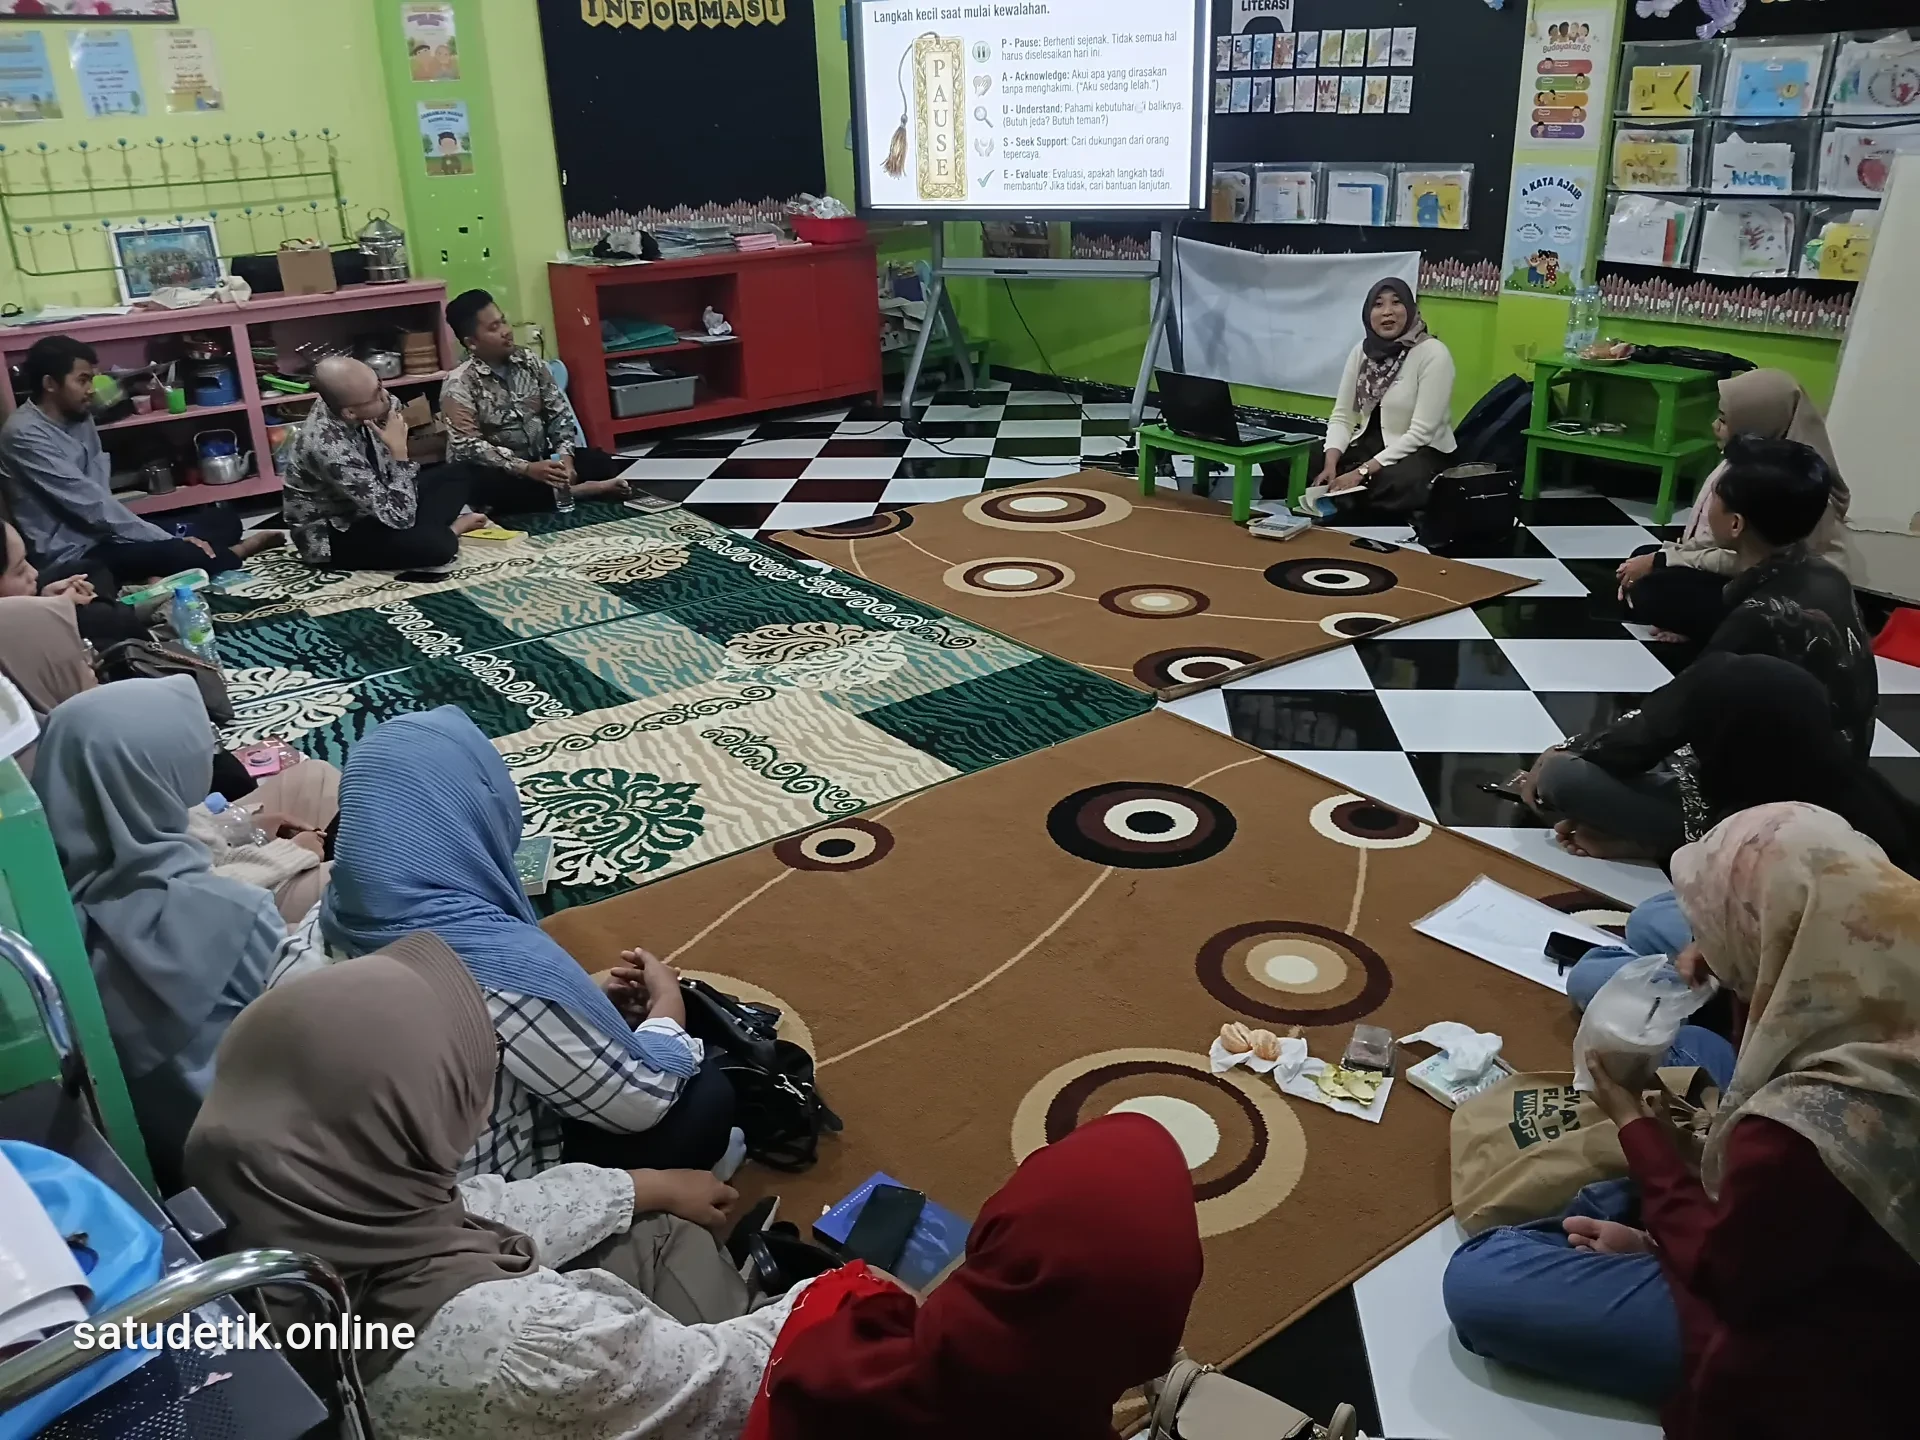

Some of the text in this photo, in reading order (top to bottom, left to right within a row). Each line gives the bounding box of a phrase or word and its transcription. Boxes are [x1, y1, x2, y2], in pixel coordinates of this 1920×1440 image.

[588, 0, 780, 20] INFORMASI
[1242, 0, 1289, 11] LITERASI
[874, 3, 1050, 24] Langkah kecil saat mulai kewalahan.
[1002, 38, 1007, 48] P
[1015, 38, 1041, 47] Pause:
[1043, 36, 1075, 47] Berhenti
[1077, 35, 1109, 47] sejenak.
[1112, 34, 1133, 43] Tidak
[1135, 34, 1162, 43] semua
[1164, 31, 1177, 41] hal
[1002, 51, 1023, 60] harus
[1025, 49, 1072, 60] diselesaikan
[1074, 48, 1088, 58] hari
[1543, 42, 1581, 53] Budayakan
[1002, 72, 1008, 82] A
[1015, 70, 1070, 82] Acknowledge:
[1072, 69, 1088, 79] Akui
[1090, 70, 1105, 80] apa
[1107, 69, 1126, 80] yang
[1128, 67, 1167, 78] dirasakan
[1002, 84, 1023, 95] tanpa
[1025, 83, 1074, 95] menghakimi.
[1100, 80, 1128, 92] sedang
[1318, 80, 1331, 93] W
[1003, 105, 1008, 114] U
[1016, 103, 1063, 114] Understand:
[1065, 103, 1093, 113] Pahami
[1149, 100, 1184, 112] baliknya.
[1003, 115, 1109, 128] (Butuh jeda? Butuh teman?)
[1003, 137, 1008, 147] S
[1016, 137, 1034, 146] Seek
[1037, 136, 1069, 148] Support:
[1072, 136, 1086, 146] Cari
[1088, 136, 1126, 147] dukungan
[1129, 135, 1144, 145] dari
[1146, 135, 1169, 146] orang
[1003, 150, 1040, 160] tepercaya.
[1004, 170, 1008, 179] E
[1016, 168, 1050, 179] Evaluate:
[1052, 168, 1085, 179] Evaluasi,
[1088, 168, 1115, 180] apakah
[1117, 168, 1148, 180] langkah
[1150, 168, 1164, 178] tadi
[1004, 180, 1172, 192] membantu? Jika tidak, cari bantuan lanjutan.
[1522, 177, 1582, 200] 4 KATA AJAIB
